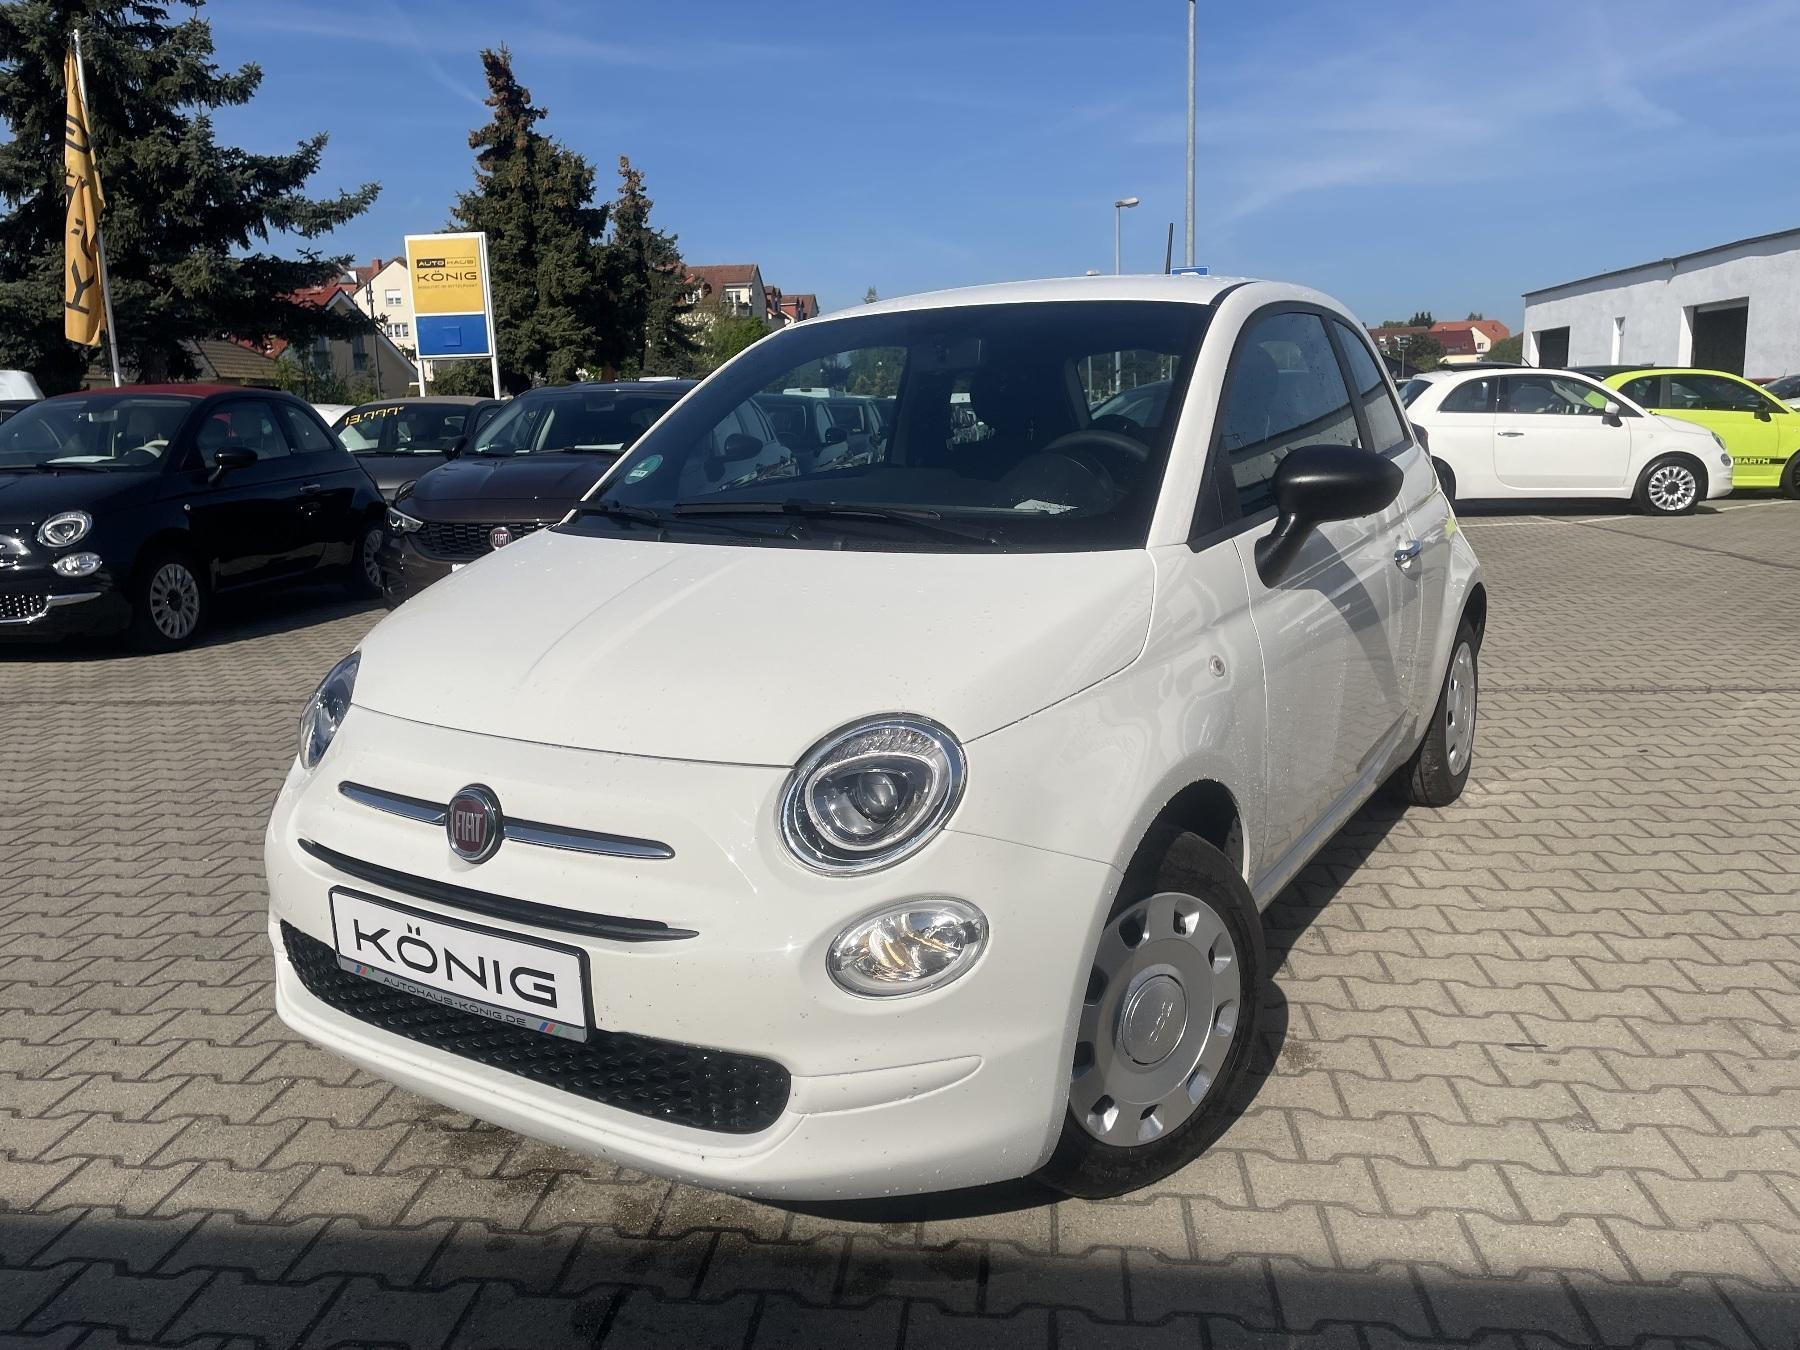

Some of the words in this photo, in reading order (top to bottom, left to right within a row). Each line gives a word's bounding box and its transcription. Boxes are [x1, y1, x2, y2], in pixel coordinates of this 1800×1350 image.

[416, 270, 477, 282] KÖNIG
[1733, 457, 1770, 465] BARTH
[494, 533, 508, 545] FIAT
[455, 810, 483, 843] FIAT
[353, 918, 558, 1009] KÖNIG
